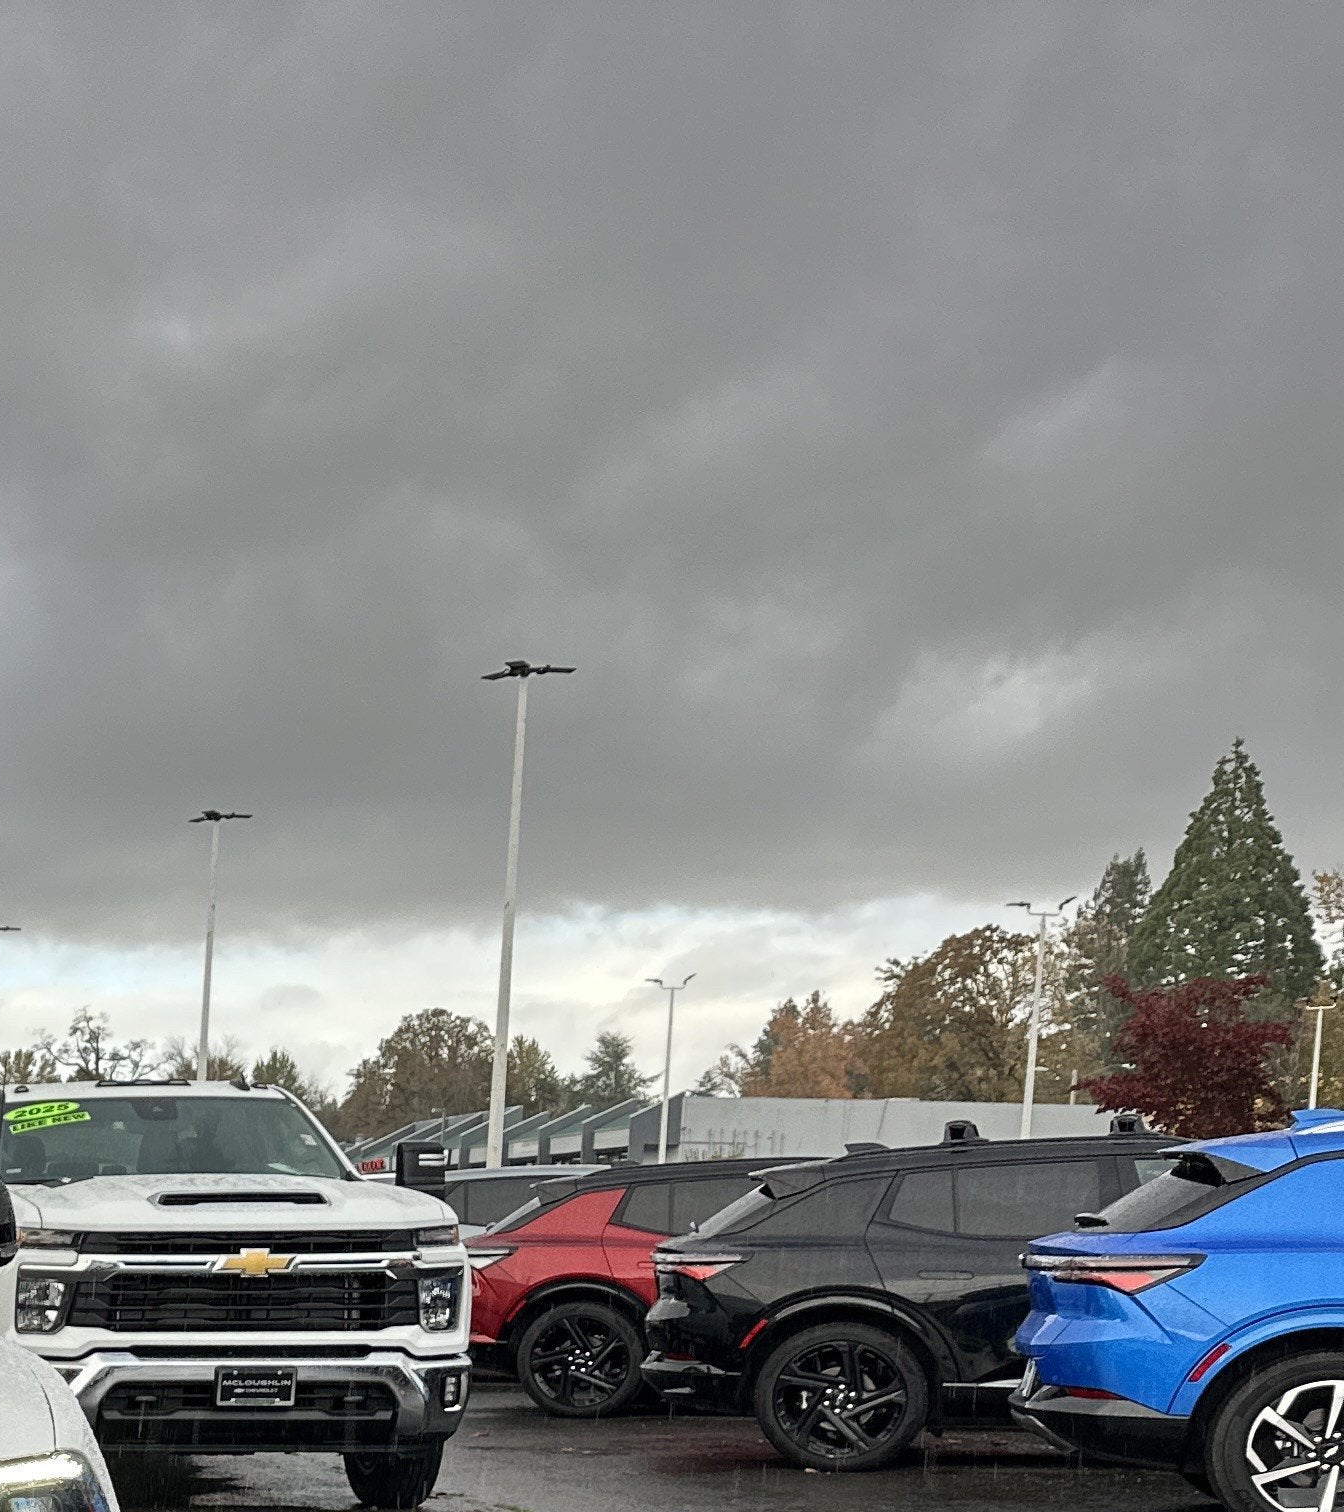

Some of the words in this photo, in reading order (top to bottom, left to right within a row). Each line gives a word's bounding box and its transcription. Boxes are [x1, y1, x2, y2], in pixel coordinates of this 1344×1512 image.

[13, 1102, 70, 1120] 2025
[12, 1119, 48, 1132] LIKE
[51, 1112, 86, 1124] NEW
